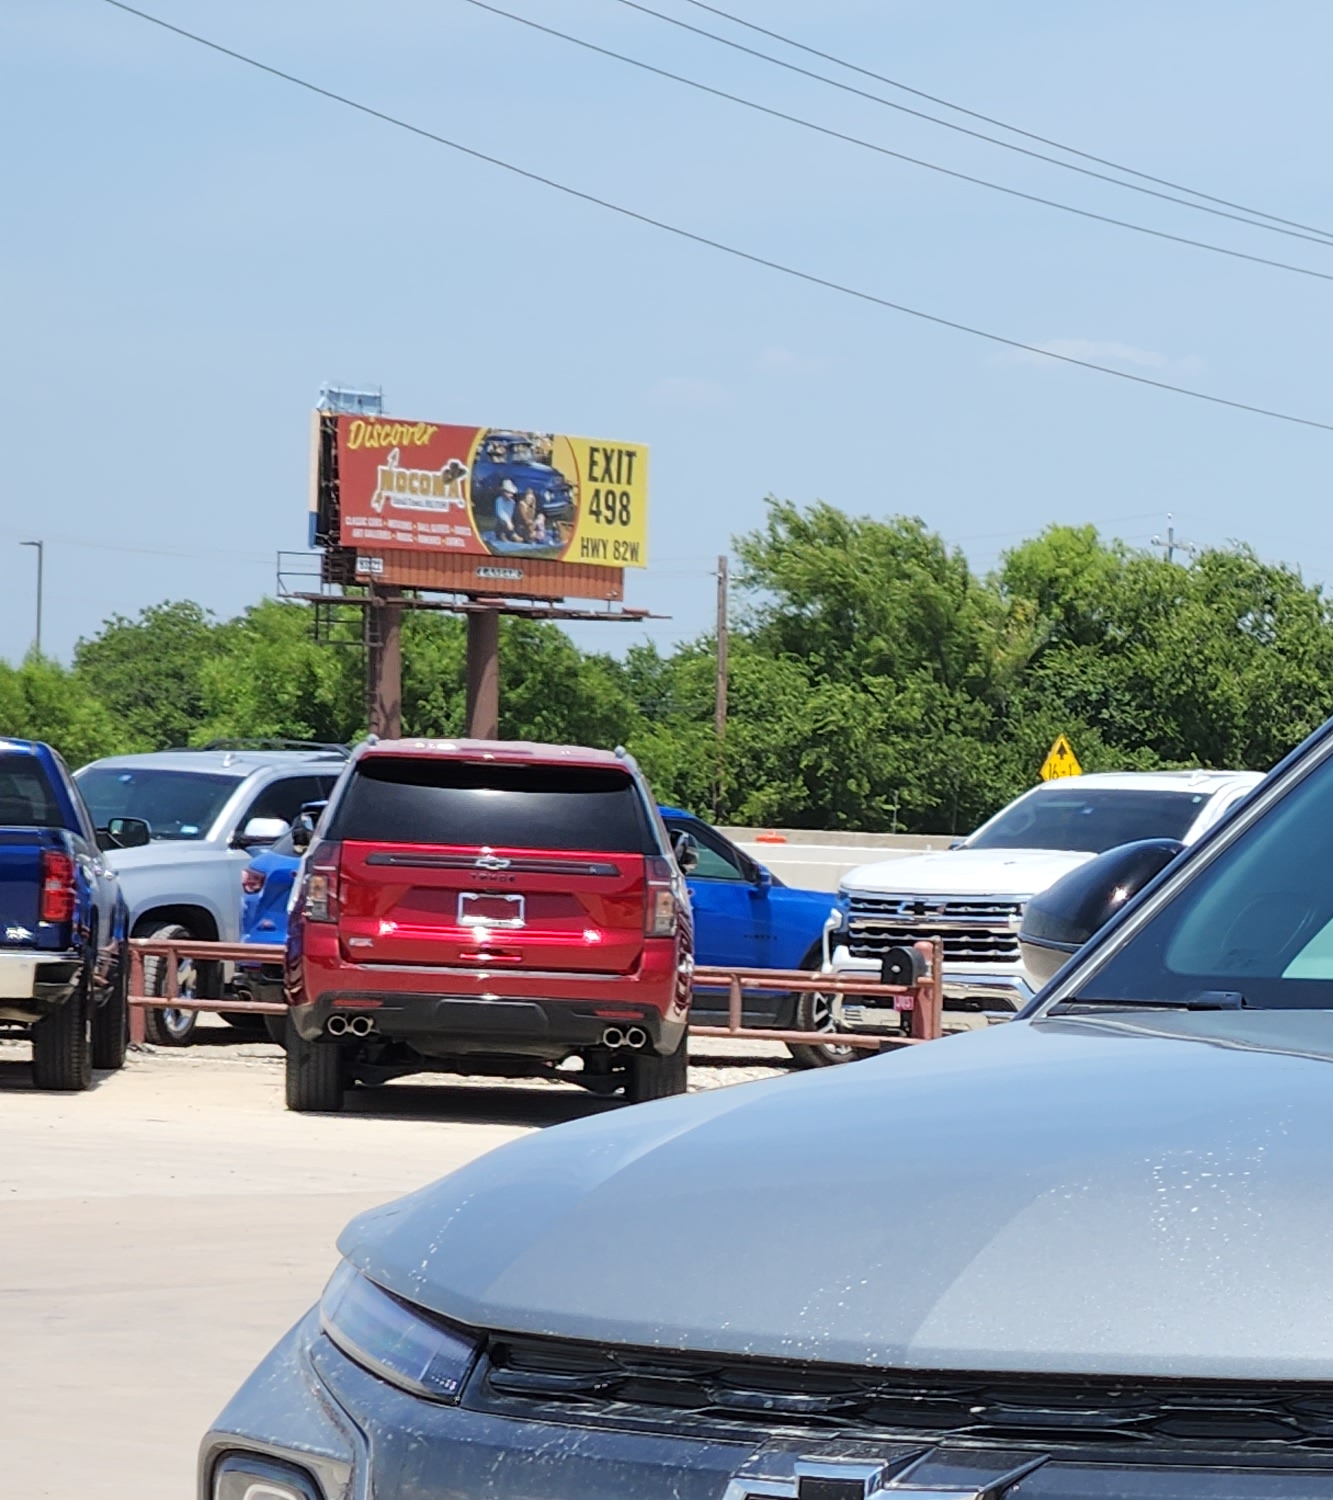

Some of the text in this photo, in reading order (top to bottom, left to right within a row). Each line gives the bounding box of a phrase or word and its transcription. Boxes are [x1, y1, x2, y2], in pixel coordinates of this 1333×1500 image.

[347, 416, 438, 450] Discover
[587, 445, 637, 486] EXIT
[587, 487, 631, 527] 498
[580, 536, 640, 563] HWY 82W
